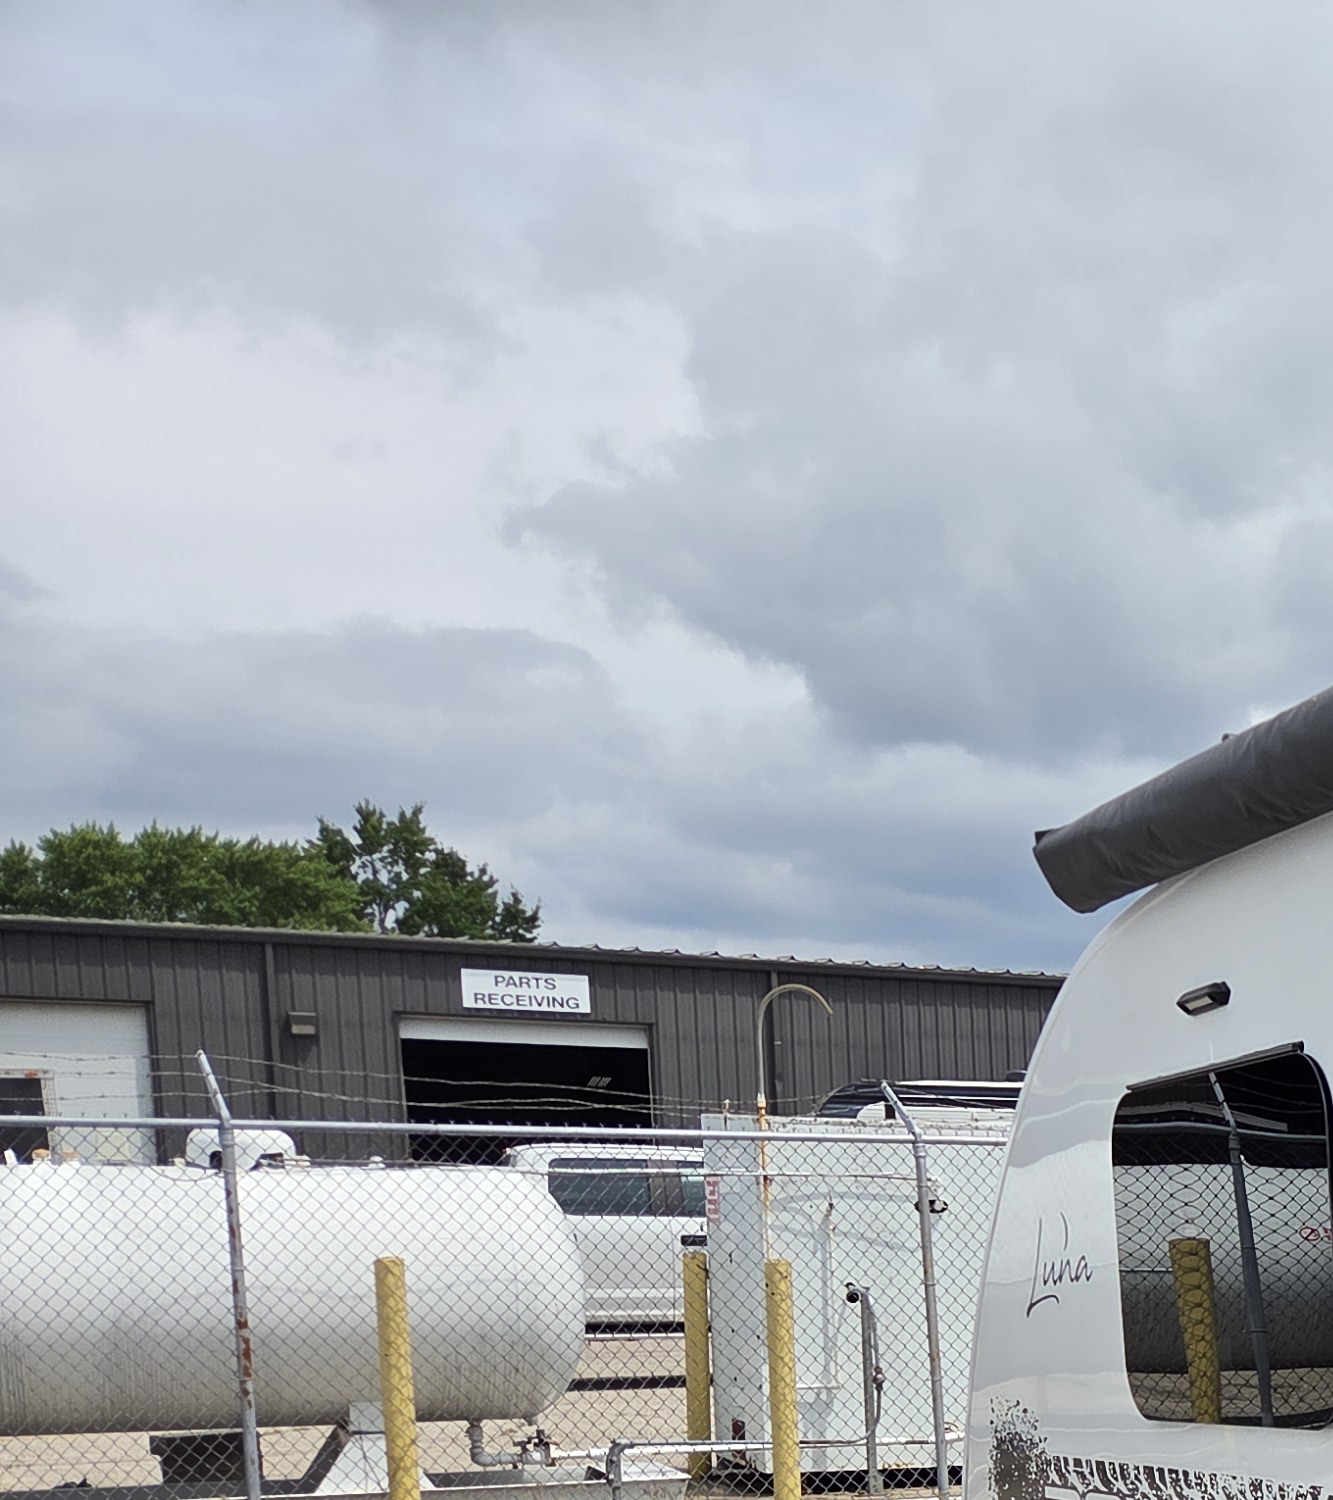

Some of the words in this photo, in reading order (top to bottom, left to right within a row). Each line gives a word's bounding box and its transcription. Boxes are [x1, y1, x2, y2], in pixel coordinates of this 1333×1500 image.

[494, 975, 557, 989] PARTS
[473, 992, 580, 1009] RECEIVING
[1026, 1211, 1093, 1318] Luna
